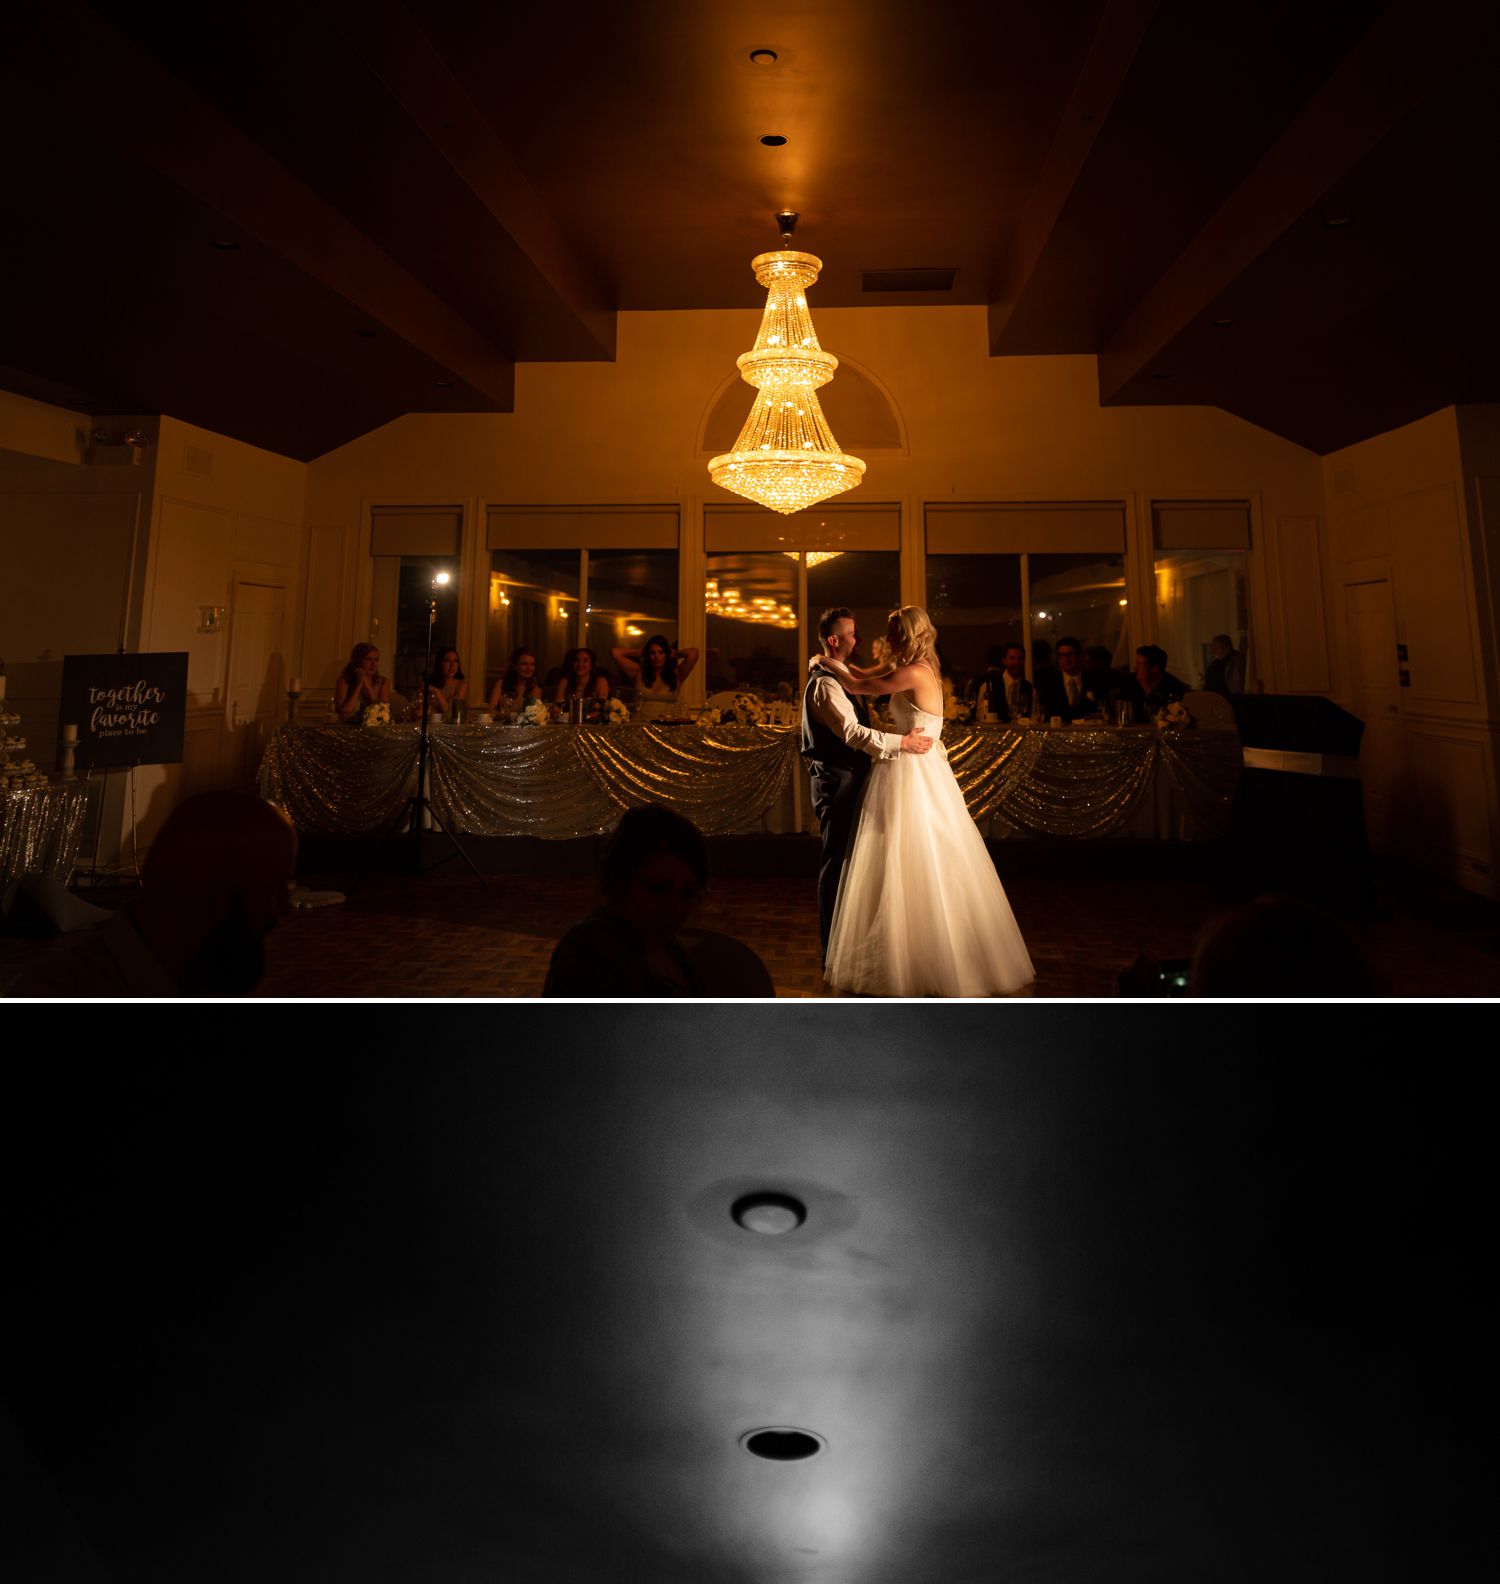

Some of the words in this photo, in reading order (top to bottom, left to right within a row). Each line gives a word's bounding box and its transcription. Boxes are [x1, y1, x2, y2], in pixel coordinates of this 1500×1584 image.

[88, 680, 166, 708] together
[124, 704, 138, 712] my
[90, 706, 160, 733] favorite
[98, 729, 123, 738] place
[136, 727, 147, 735] be
